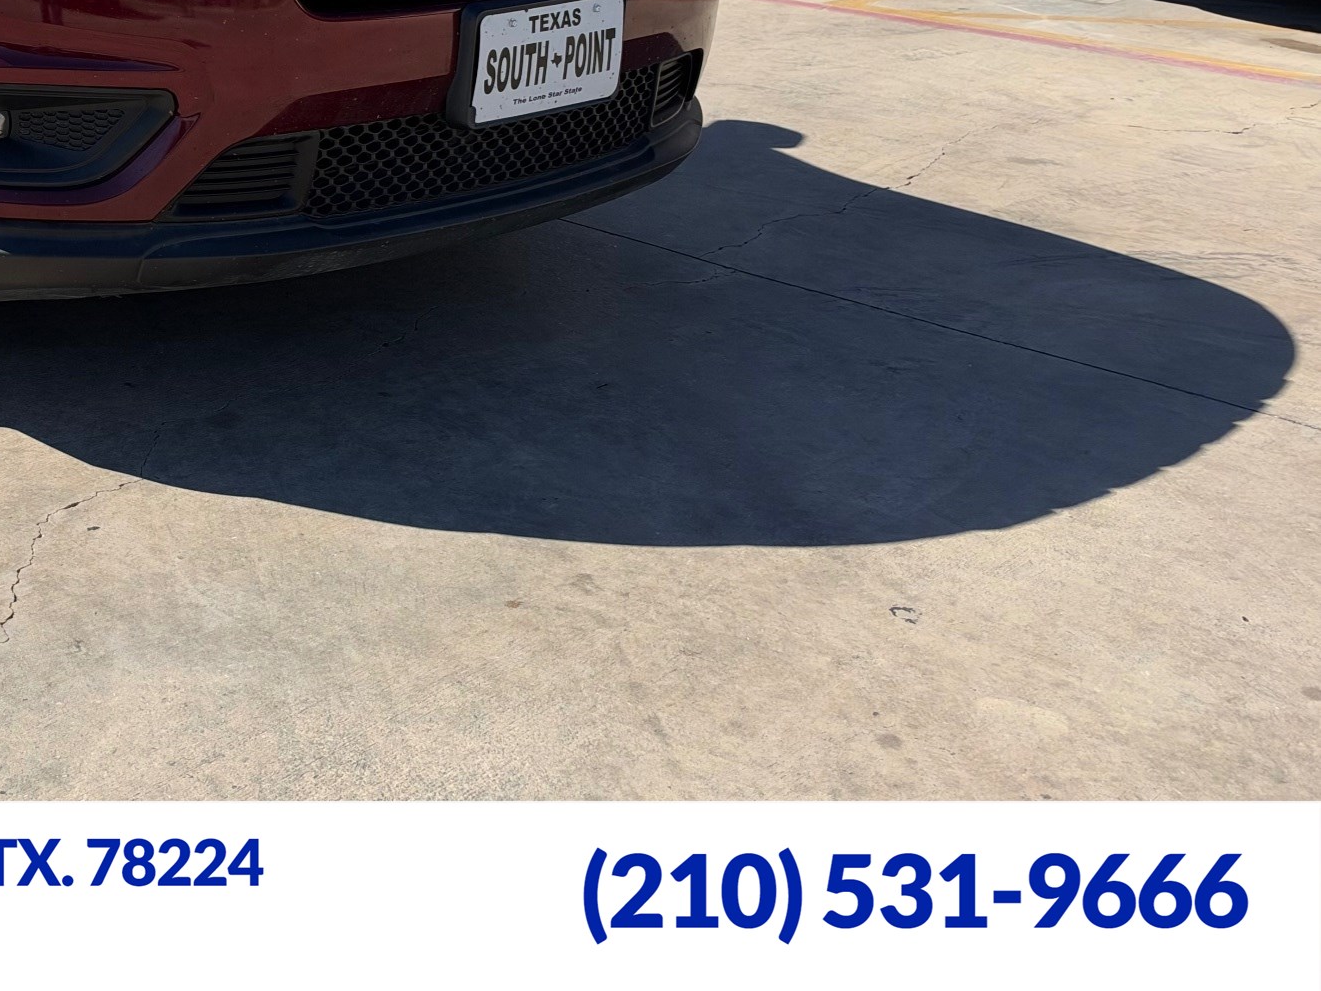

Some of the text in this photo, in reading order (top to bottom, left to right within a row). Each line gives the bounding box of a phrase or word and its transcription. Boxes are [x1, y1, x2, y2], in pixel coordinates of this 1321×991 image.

[529, 8, 582, 33] TEXAS
[484, 27, 616, 95] SOUTH POINT
[513, 86, 583, 105] The Lone Star State
